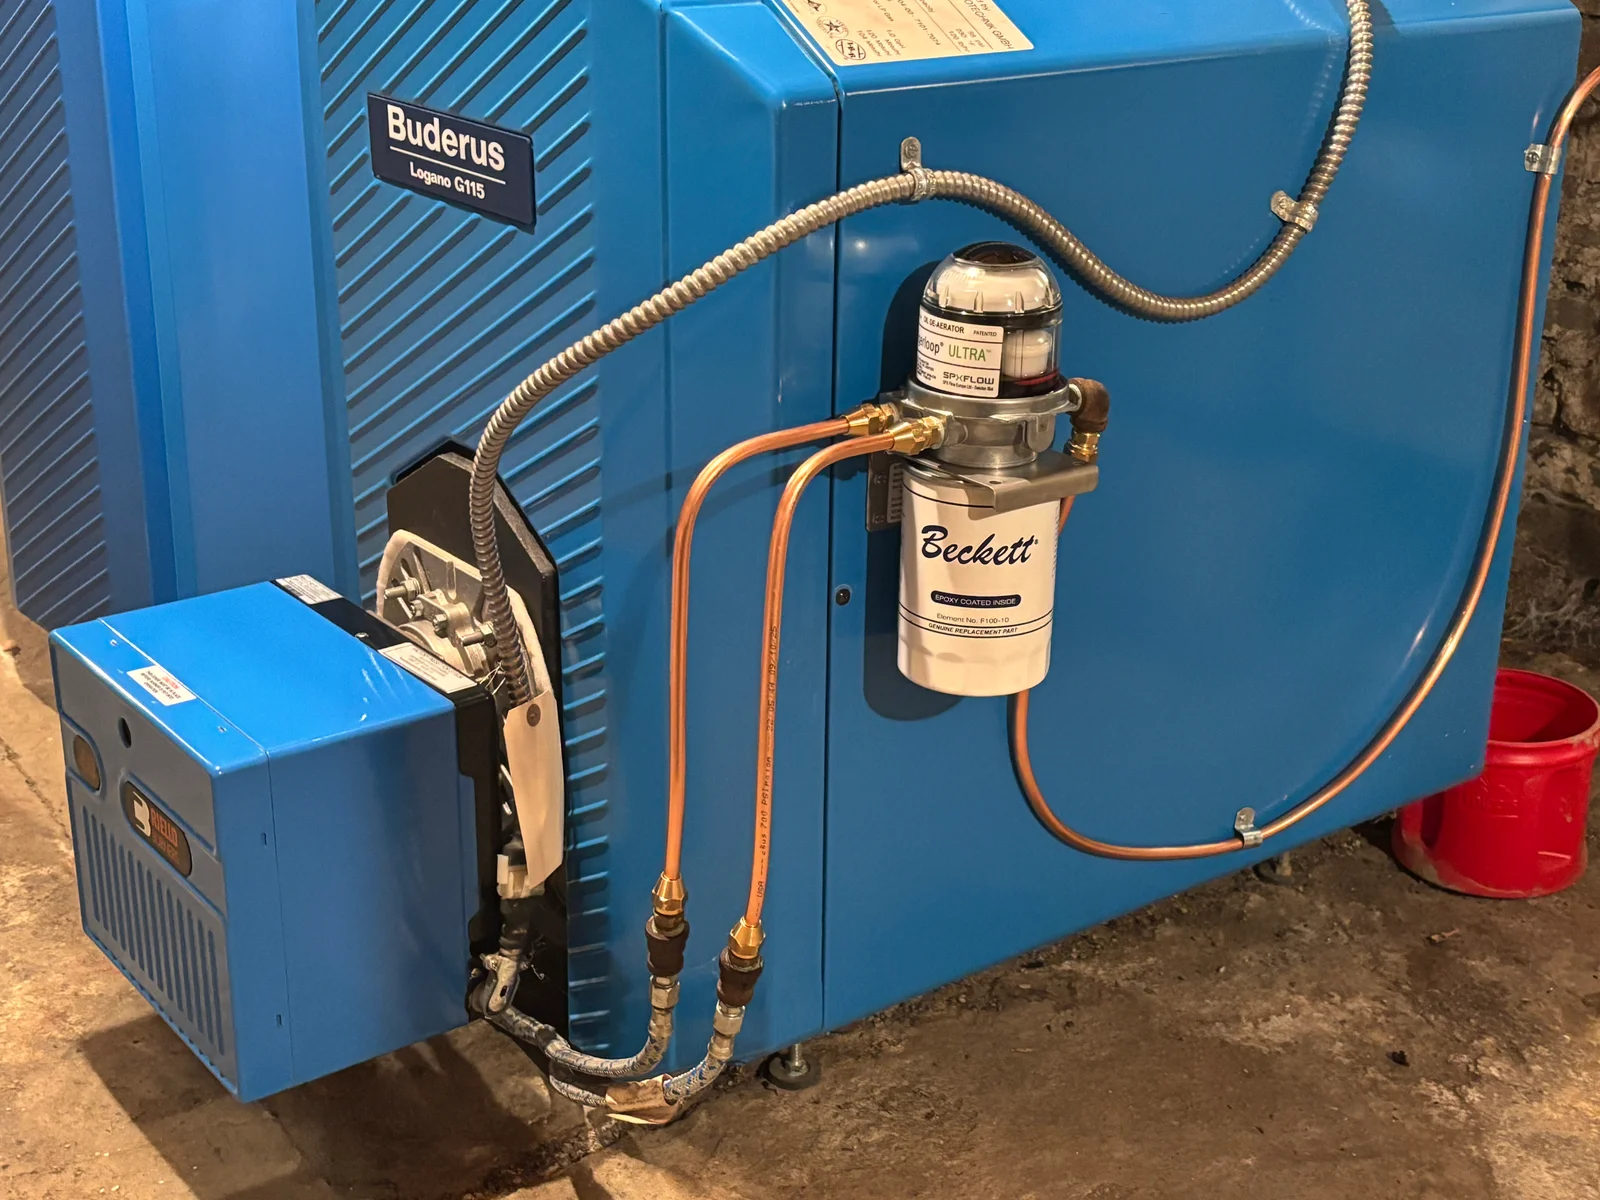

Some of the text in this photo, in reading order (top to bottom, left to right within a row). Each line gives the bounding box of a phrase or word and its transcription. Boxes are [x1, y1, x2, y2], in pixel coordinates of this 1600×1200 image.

[386, 103, 506, 171] Buderus
[409, 161, 486, 199] Logano G115
[929, 318, 965, 334] DE-AERATOR
[973, 329, 997, 337] PATENTED
[948, 343, 987, 362] ULTRA
[921, 524, 1036, 566] Beckett
[935, 594, 959, 604] EPOXY
[960, 598, 992, 606] COATED
[928, 622, 954, 633] GENUINE
[936, 613, 965, 623] Element
